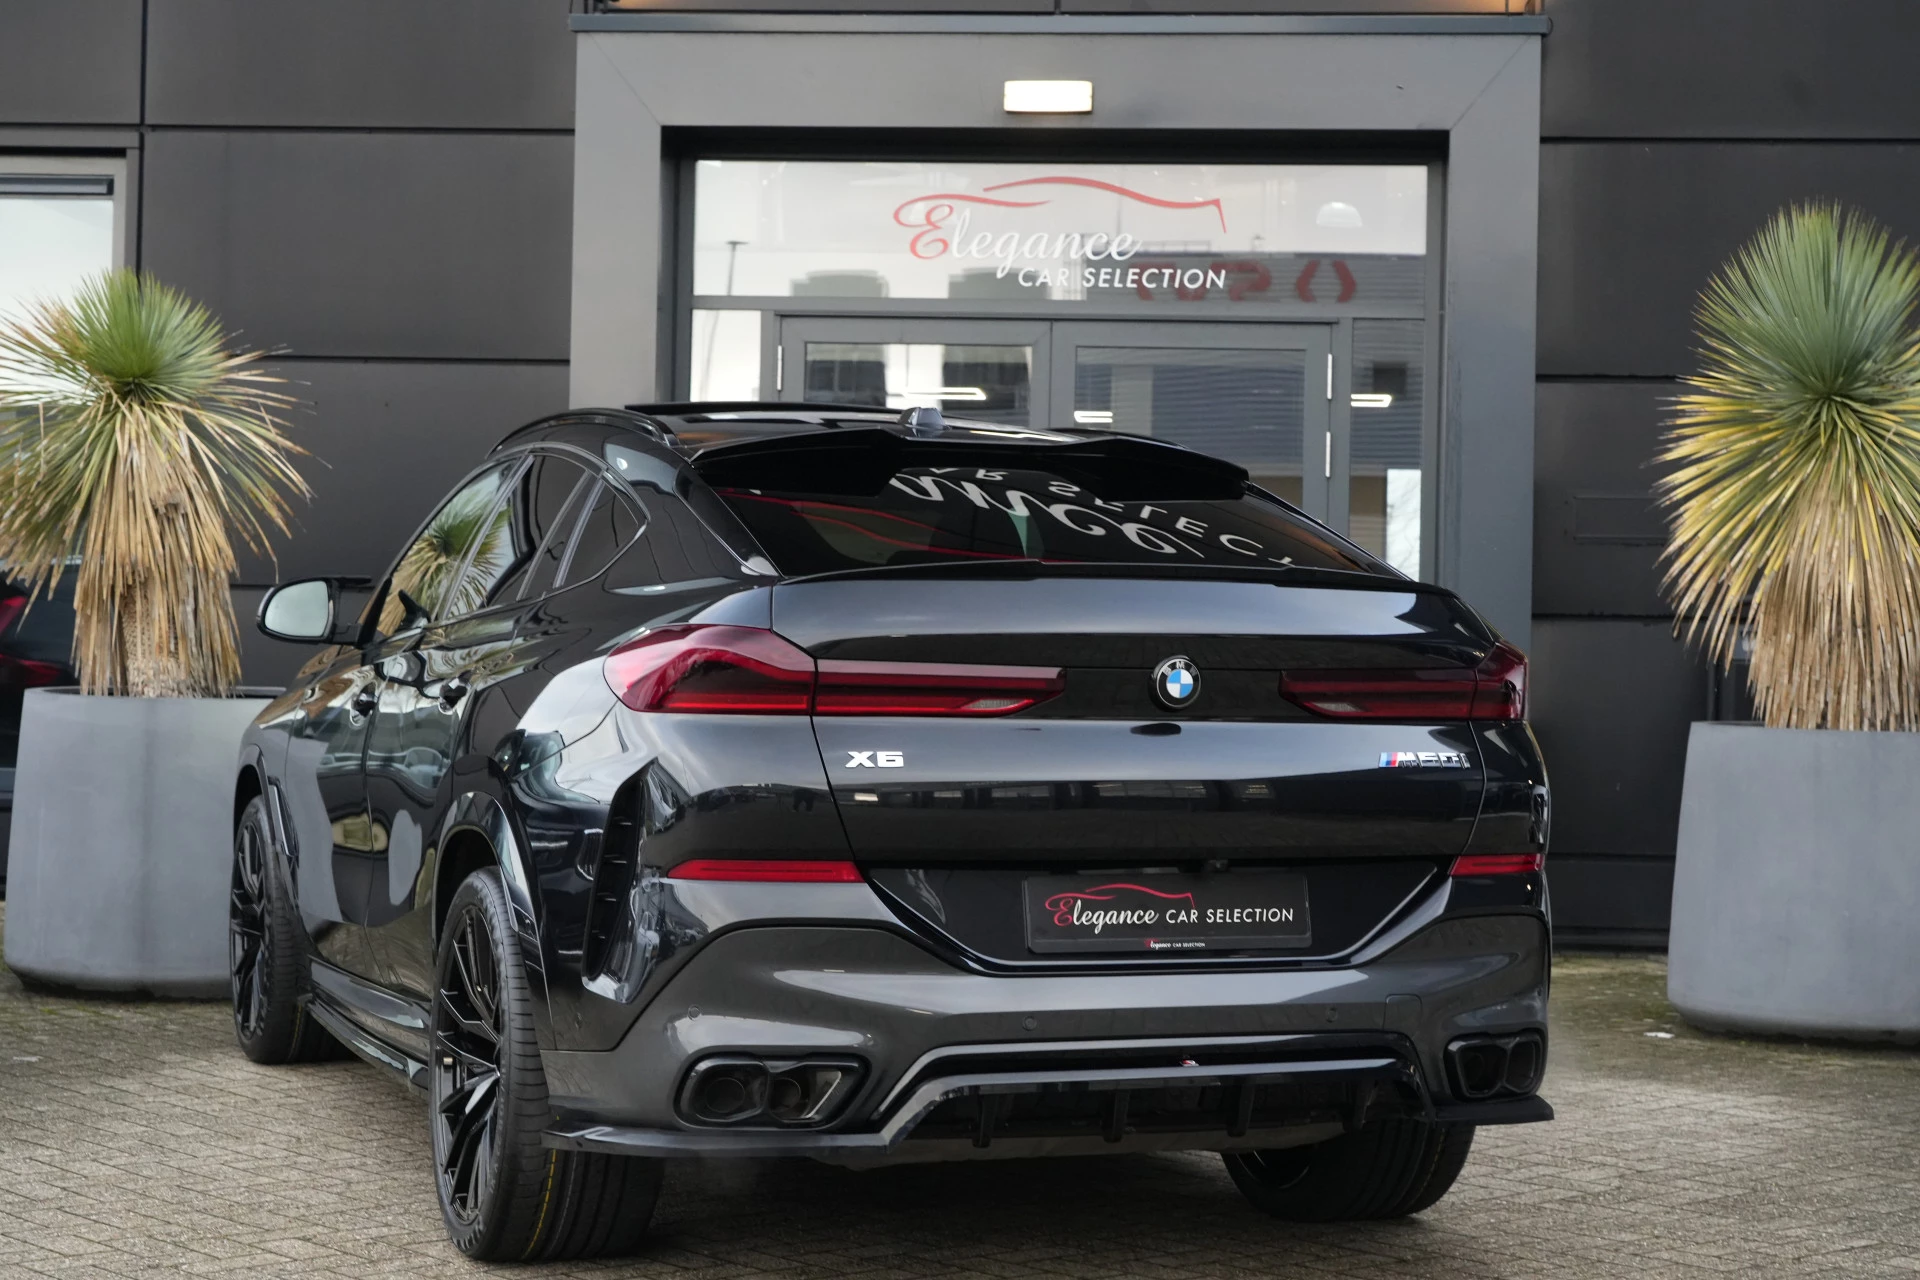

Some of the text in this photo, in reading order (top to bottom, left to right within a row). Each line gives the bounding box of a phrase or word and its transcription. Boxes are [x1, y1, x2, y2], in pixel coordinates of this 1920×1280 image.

[902, 203, 1142, 279] Elegance
[1018, 268, 1069, 288] CAR
[1082, 267, 1226, 290] SELECTION
[845, 751, 904, 768] X6
[1053, 898, 1294, 934] Elegance CAR SELECTION
